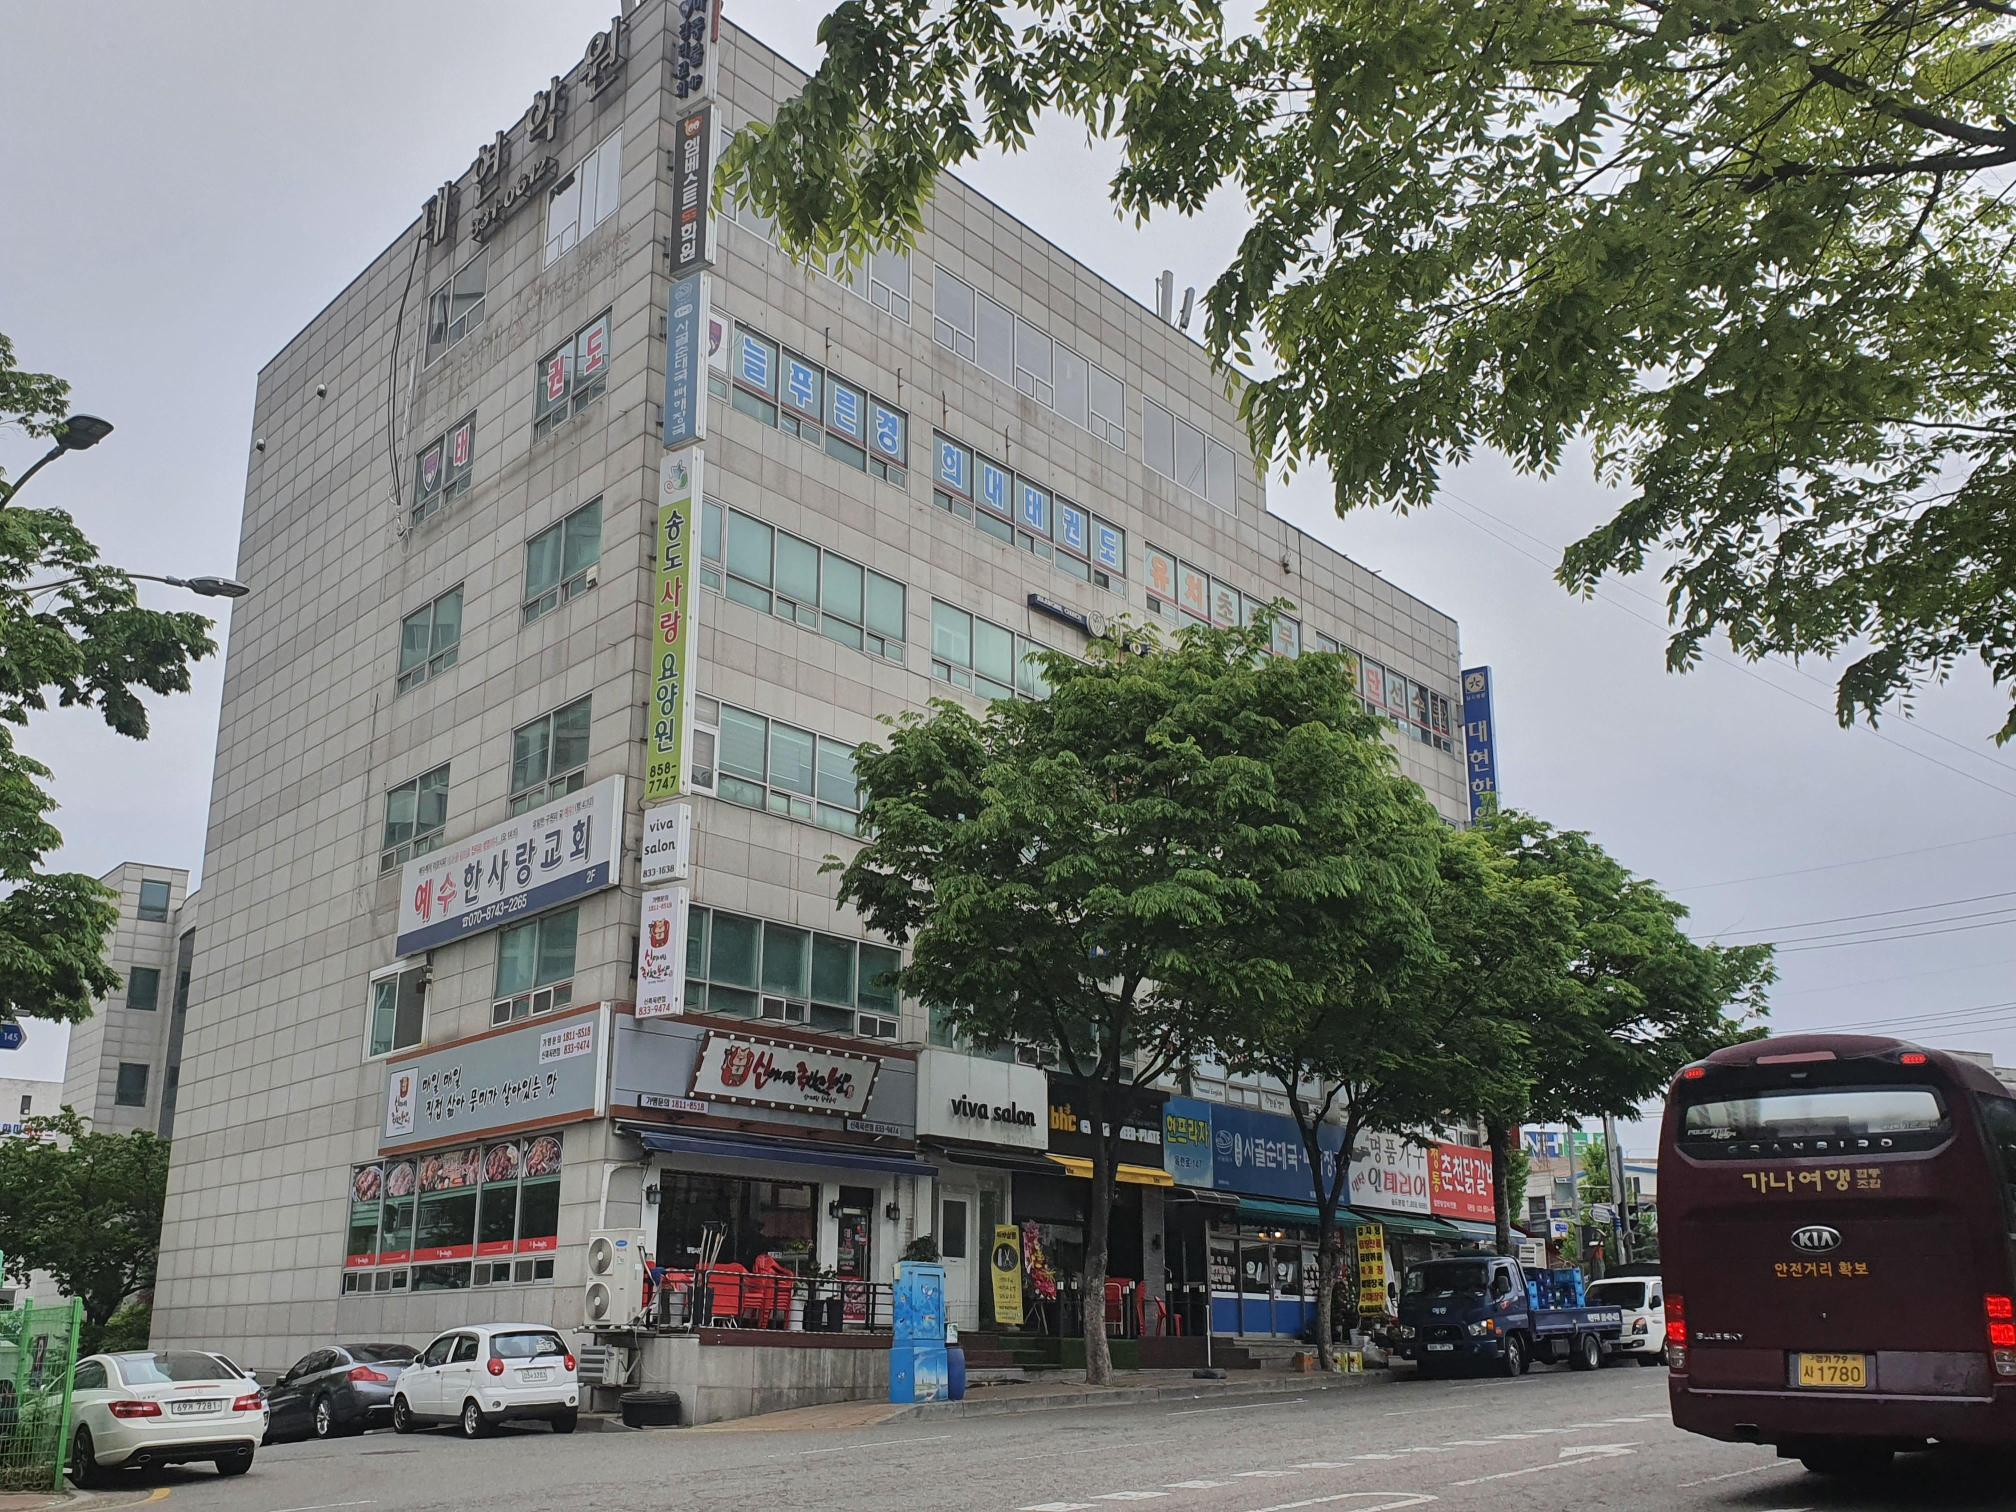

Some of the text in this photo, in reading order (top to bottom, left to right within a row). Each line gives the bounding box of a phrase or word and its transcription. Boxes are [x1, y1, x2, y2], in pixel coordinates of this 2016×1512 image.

[648, 775, 677, 795] 7747
[649, 817, 674, 833] viva
[644, 839, 676, 856] salon
[585, 869, 596, 884] 2F
[642, 865, 675, 879] 833-1638
[467, 893, 528, 926] 070-8743-2265
[638, 1003, 671, 1017] 833-9474
[3, 1032, 19, 1042] 145
[422, 1065, 462, 1094] 매일 매일
[425, 1098, 443, 1124] 직접
[447, 1094, 465, 1118] 삶아
[501, 1077, 542, 1106] 살아있는
[546, 1071, 558, 1096] 맛
[951, 1094, 1037, 1127] viva salon
[1050, 1105, 1078, 1133] bhc
[1727, 1138, 1894, 1154] GRANBIRD
[1742, 1170, 1852, 1194] 가나여행
[1799, 1230, 1833, 1247] KIA
[1774, 1261, 1870, 1278] 안전거리 확보
[1818, 1365, 1861, 1382] 1780
